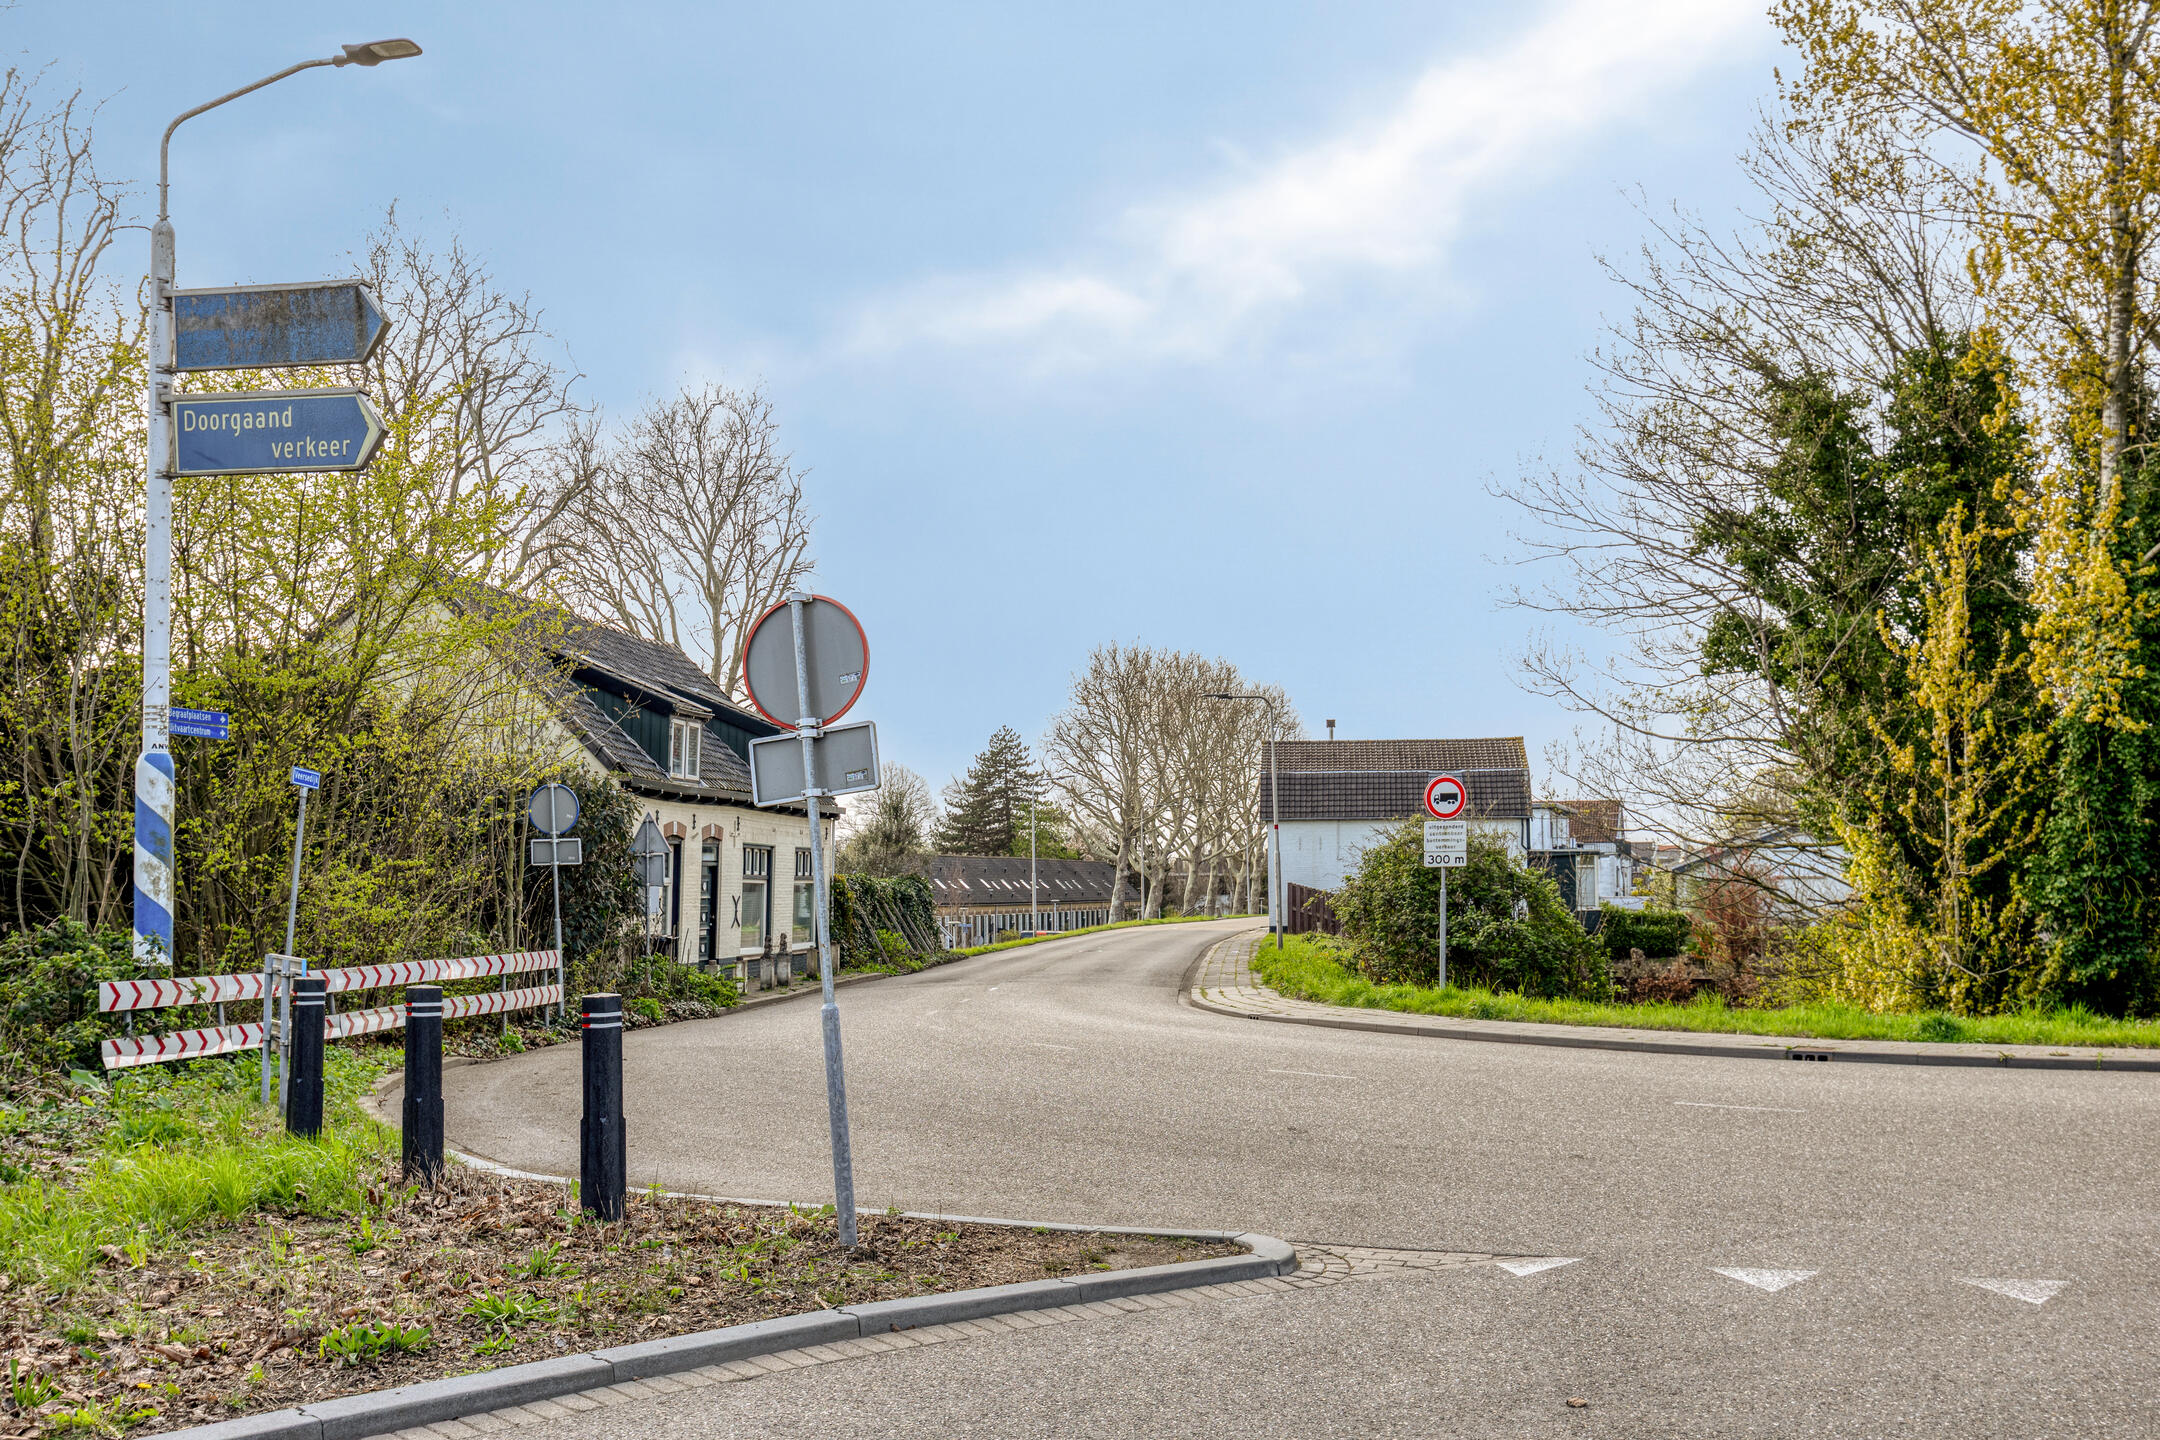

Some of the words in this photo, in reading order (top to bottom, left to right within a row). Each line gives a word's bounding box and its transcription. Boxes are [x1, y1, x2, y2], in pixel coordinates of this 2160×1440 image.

[183, 406, 292, 437] Doorgaand
[272, 436, 351, 458] verkeer
[169, 708, 212, 721] Begraafplaatsen
[1427, 854, 1450, 865] 300
[1454, 856, 1465, 864] m
